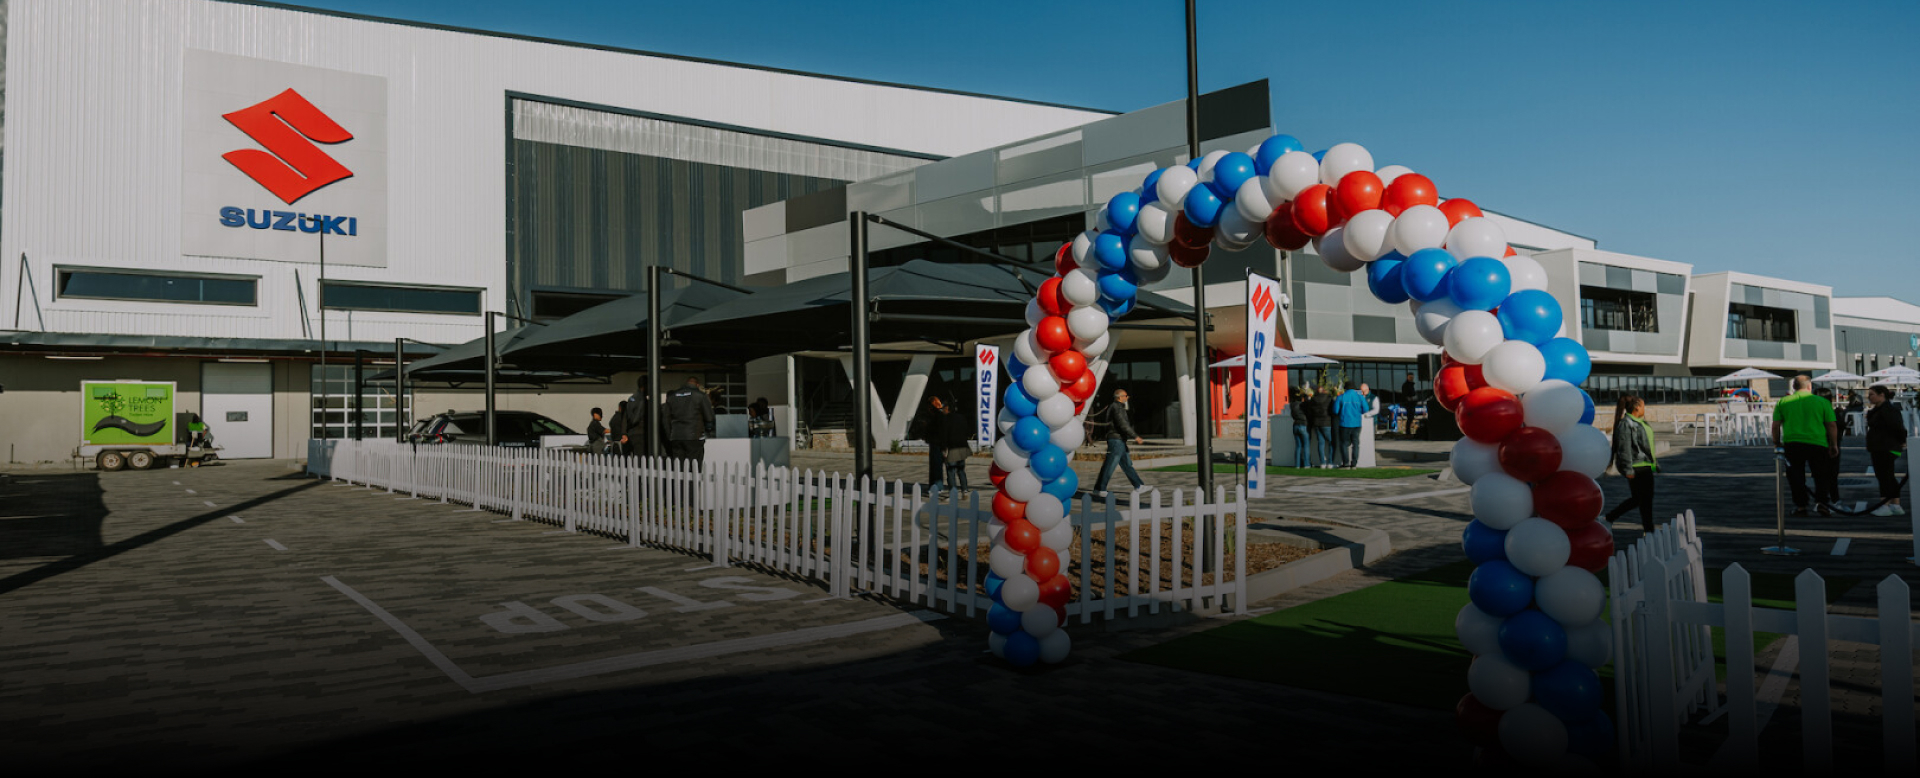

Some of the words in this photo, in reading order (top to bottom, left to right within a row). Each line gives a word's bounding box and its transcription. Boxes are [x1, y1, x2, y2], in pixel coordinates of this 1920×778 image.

[219, 206, 358, 236] SUZUKI
[128, 396, 162, 404] LEMON
[128, 404, 156, 412] TREES
[980, 370, 992, 441] SUZUKI
[1247, 330, 1265, 489] SUZUKI
[479, 576, 803, 633] STOP
